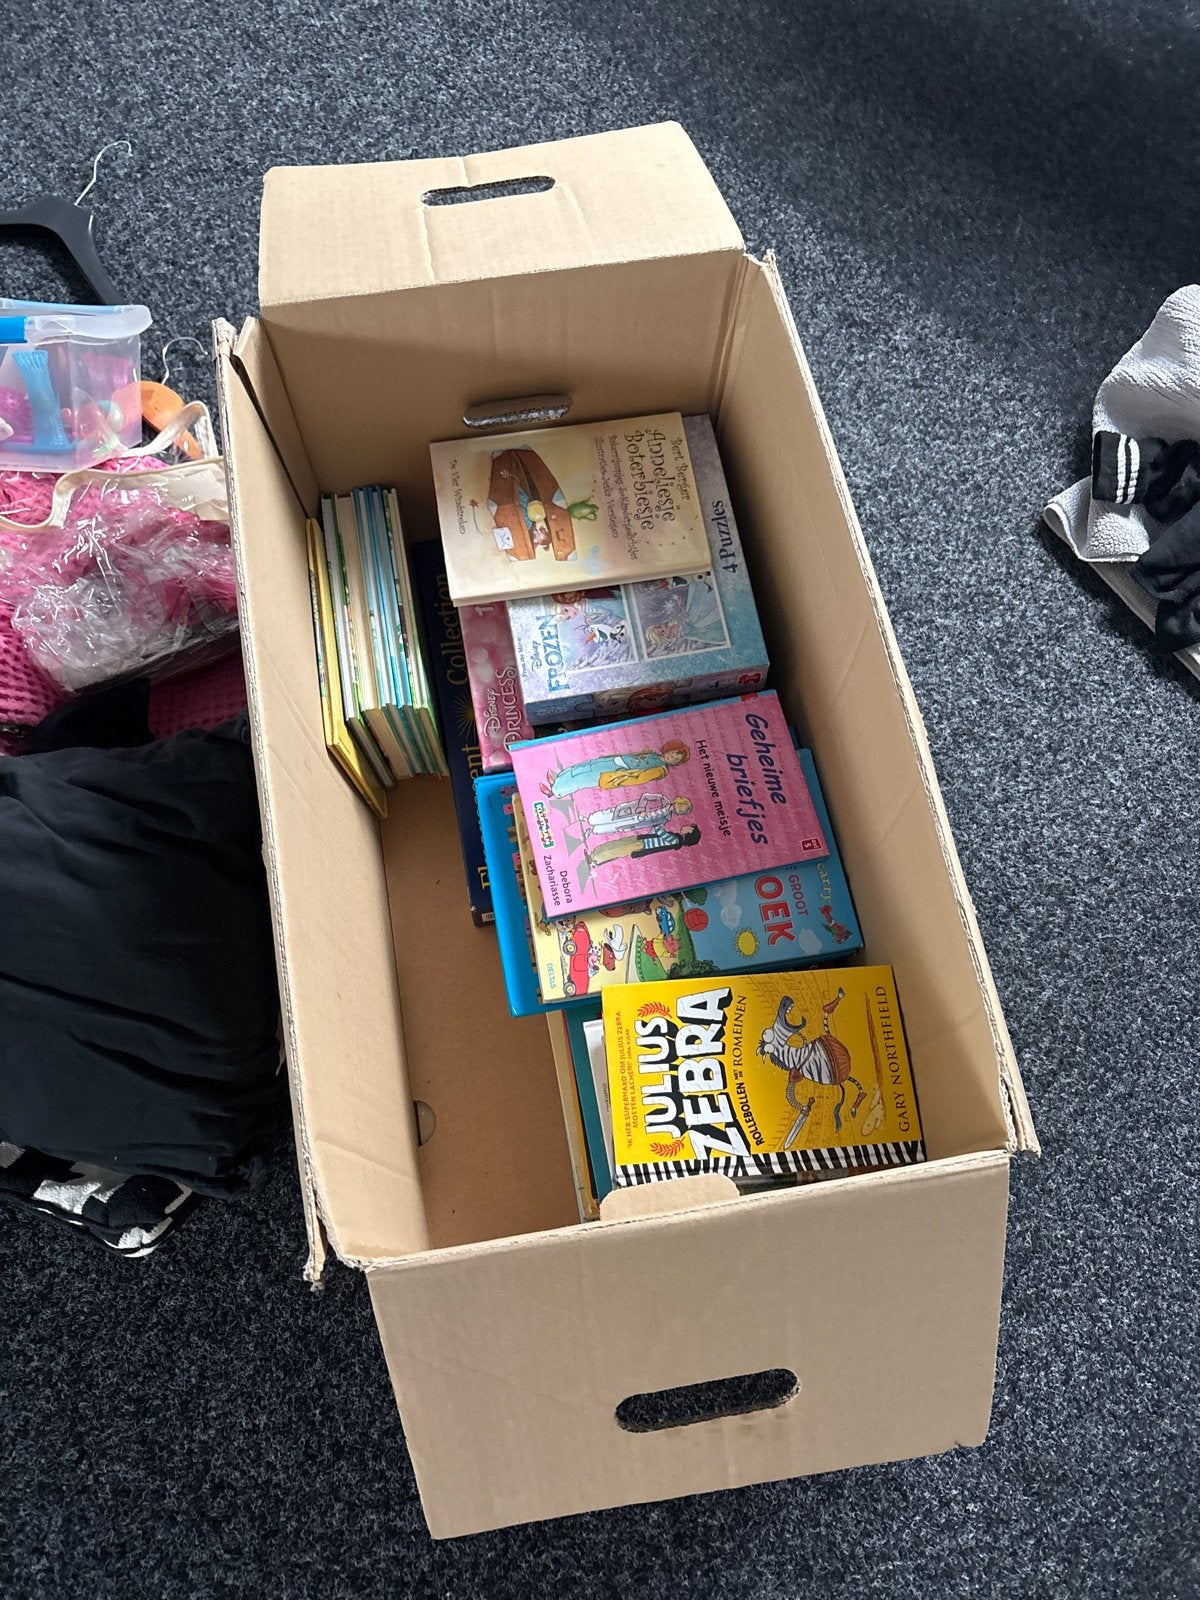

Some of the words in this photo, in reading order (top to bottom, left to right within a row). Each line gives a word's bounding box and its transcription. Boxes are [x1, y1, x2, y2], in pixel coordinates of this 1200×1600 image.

[624, 430, 659, 530] Boterbiesje
[645, 429, 680, 521] Anneliesje
[670, 437, 684, 461] Bert
[676, 463, 691, 501] Berger
[711, 500, 736, 560] Puzzles
[722, 563, 738, 574] 4
[434, 573, 468, 686] Collection
[536, 614, 571, 692] FROZEN
[496, 666, 524, 750] PRINCESS
[695, 739, 709, 760] Het
[702, 763, 720, 799] nieuwe
[714, 801, 731, 837] meisje
[745, 713, 787, 805] Geheime
[726, 753, 768, 845] briefjes
[543, 854, 561, 907] Zachariasse
[559, 870, 573, 904] Debora
[755, 875, 797, 947] OEK
[789, 874, 809, 916] GROOT
[815, 863, 832, 902] carry
[615, 1011, 623, 1036] ZEBRA
[617, 1036, 626, 1060] JULIUS
[732, 995, 747, 1067] ROMEINEN
[875, 986, 902, 1085] NORTHFIELD
[619, 1060, 627, 1074] OM
[621, 1075, 631, 1121] SUPERHARD
[634, 1016, 685, 1139] JULIUS
[675, 986, 751, 1160] ZEBRA
[629, 1096, 639, 1129] MOETEN
[736, 1082, 765, 1146] ROLLEBOLLEN
[894, 1091, 910, 1132] GARY
